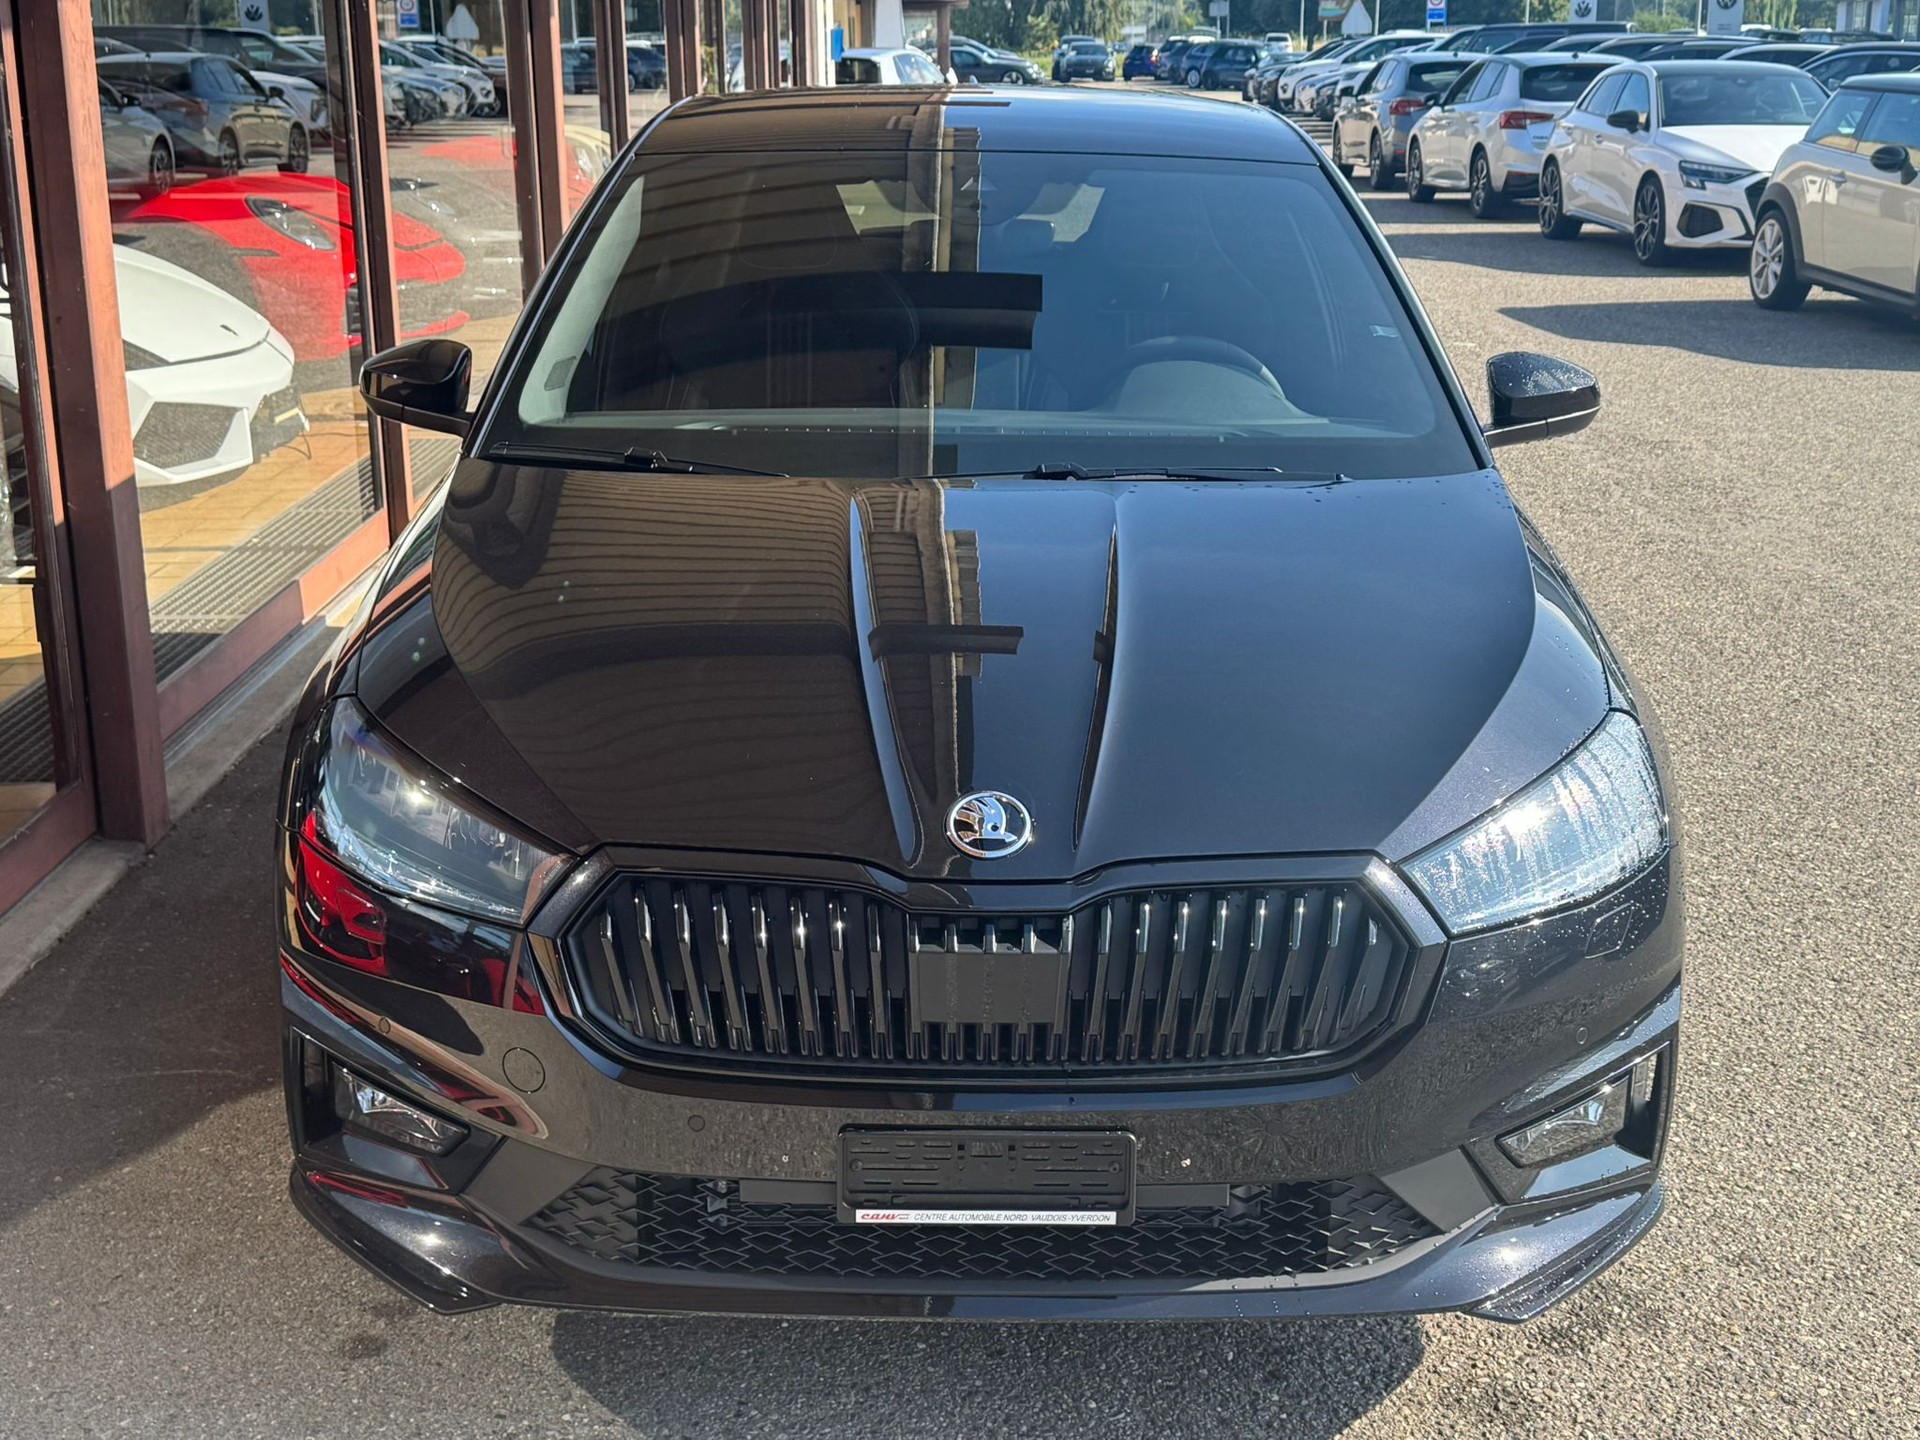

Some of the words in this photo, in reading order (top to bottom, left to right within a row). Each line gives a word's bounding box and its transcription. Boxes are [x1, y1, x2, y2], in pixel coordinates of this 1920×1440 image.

[914, 1213, 947, 1222] CENTRE
[948, 1213, 1002, 1222] AUTOMOBILE
[1003, 1213, 1028, 1222] NORD
